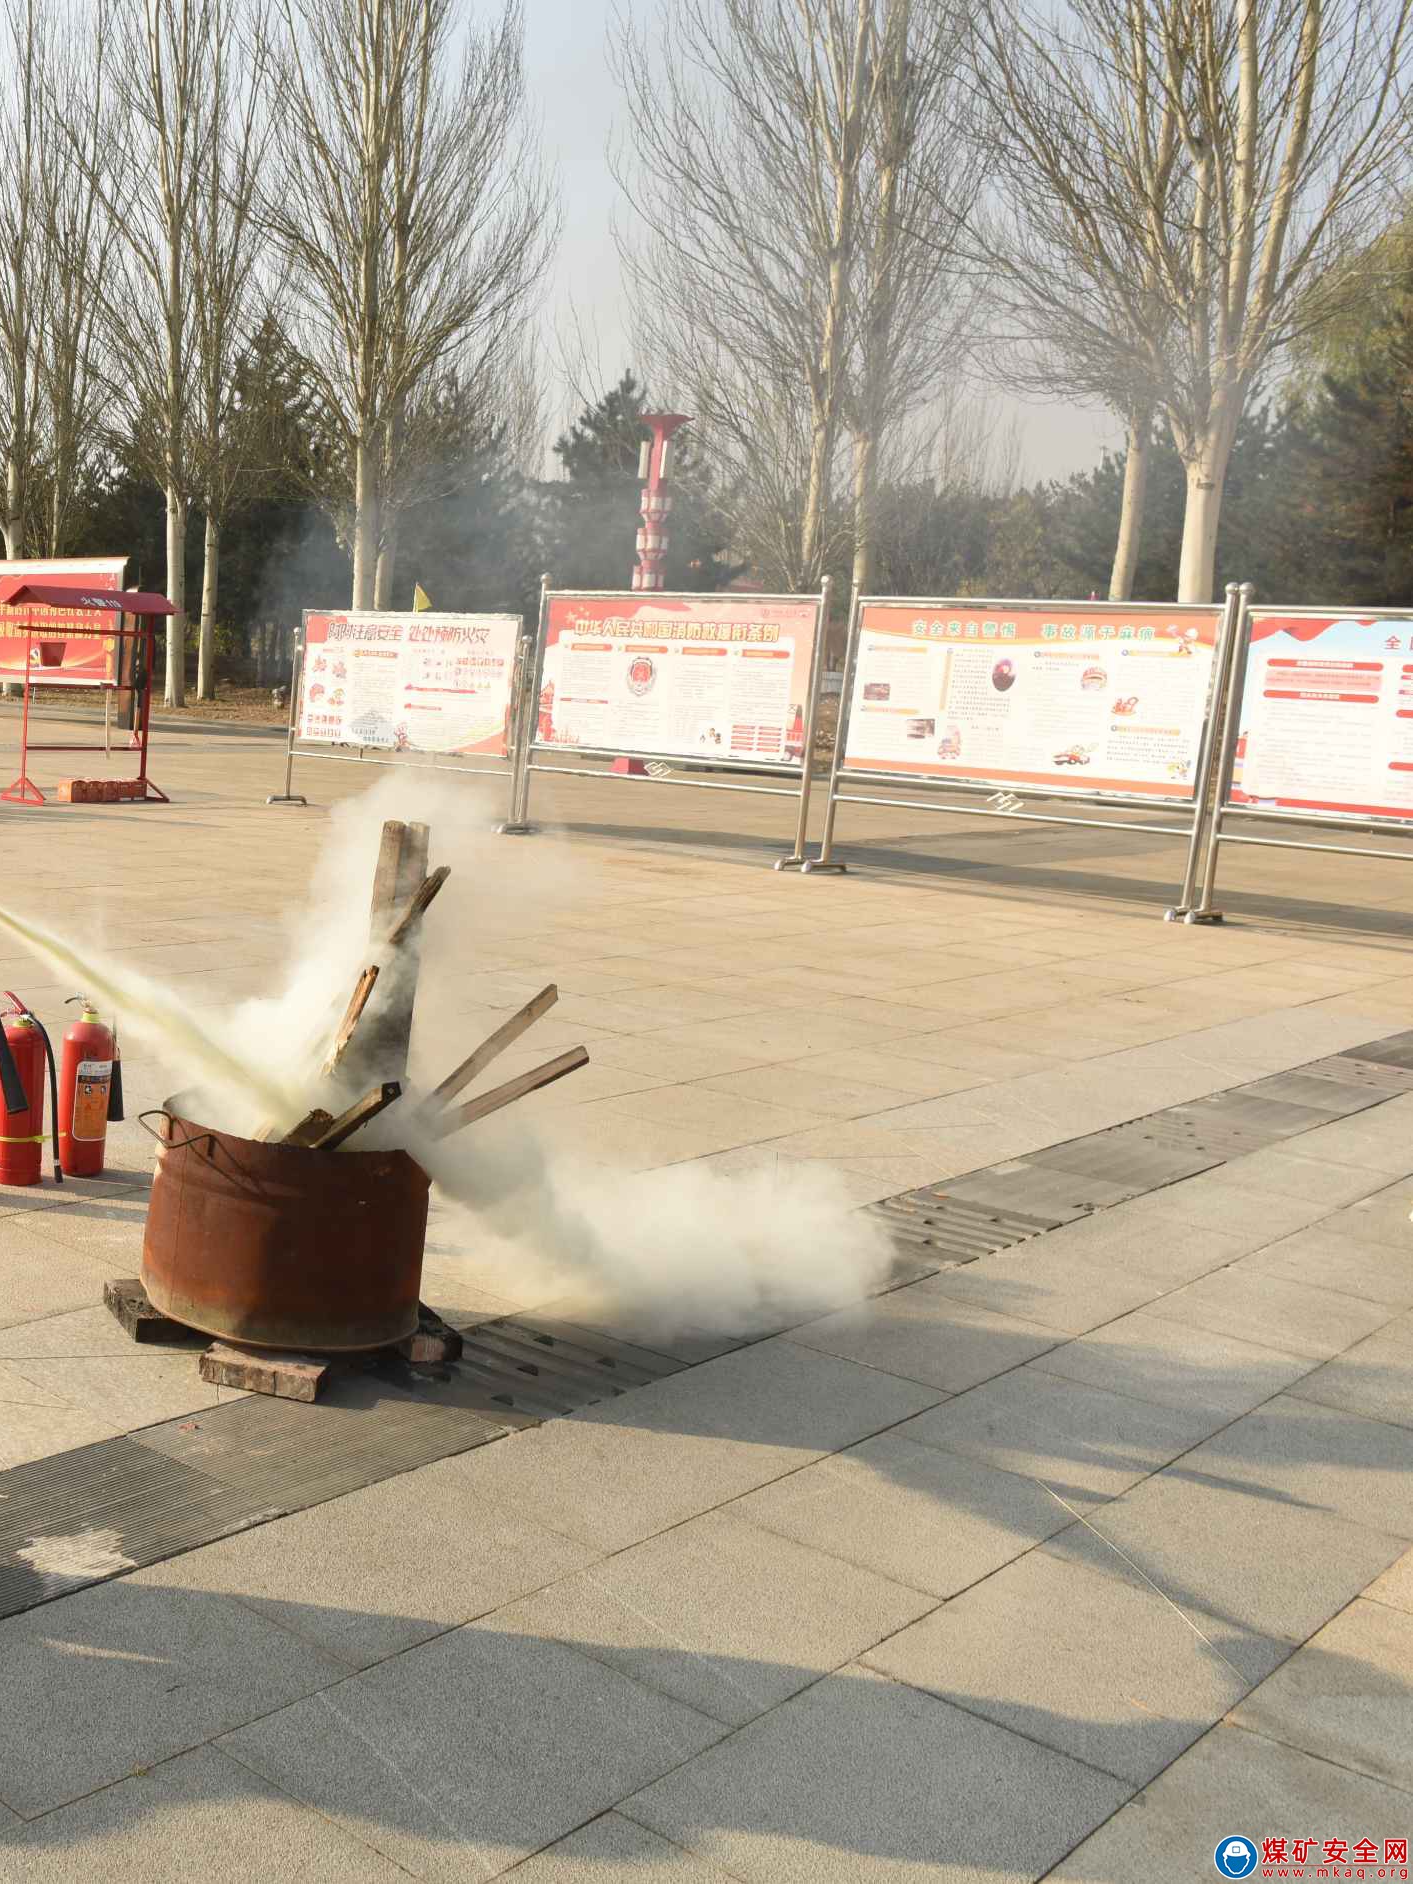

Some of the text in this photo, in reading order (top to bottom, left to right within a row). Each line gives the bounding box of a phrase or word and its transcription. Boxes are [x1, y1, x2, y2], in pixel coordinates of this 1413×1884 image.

[574, 618, 780, 642] 中华人民共和国消防救援衔条例
[1384, 634, 1413, 651] 全
